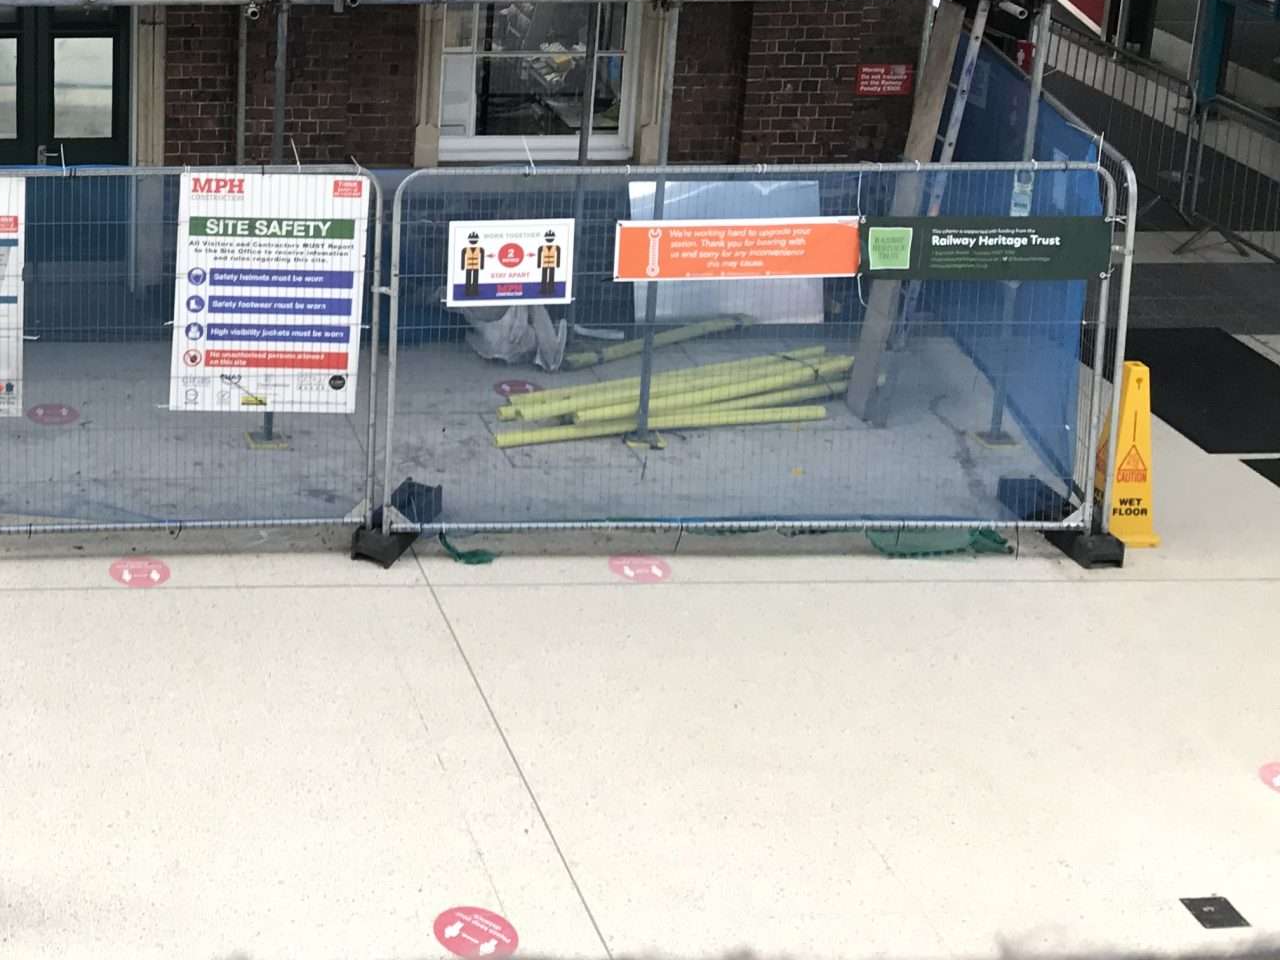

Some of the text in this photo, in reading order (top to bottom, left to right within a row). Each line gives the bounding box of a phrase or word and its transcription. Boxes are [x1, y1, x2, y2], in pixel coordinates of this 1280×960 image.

[192, 178, 244, 194] MPH
[206, 219, 331, 237] SITE SAFETY
[931, 234, 1061, 248] Railway Heritage Trust
[506, 248, 516, 258] 2
[214, 273, 238, 282] Safety
[293, 274, 303, 282] be
[212, 300, 237, 309] Safety
[238, 300, 273, 309] footwear
[295, 301, 305, 309] be
[210, 328, 229, 337] High
[312, 329, 322, 337] be
[1119, 498, 1142, 506] WET
[1112, 507, 1148, 516] FLOOR
